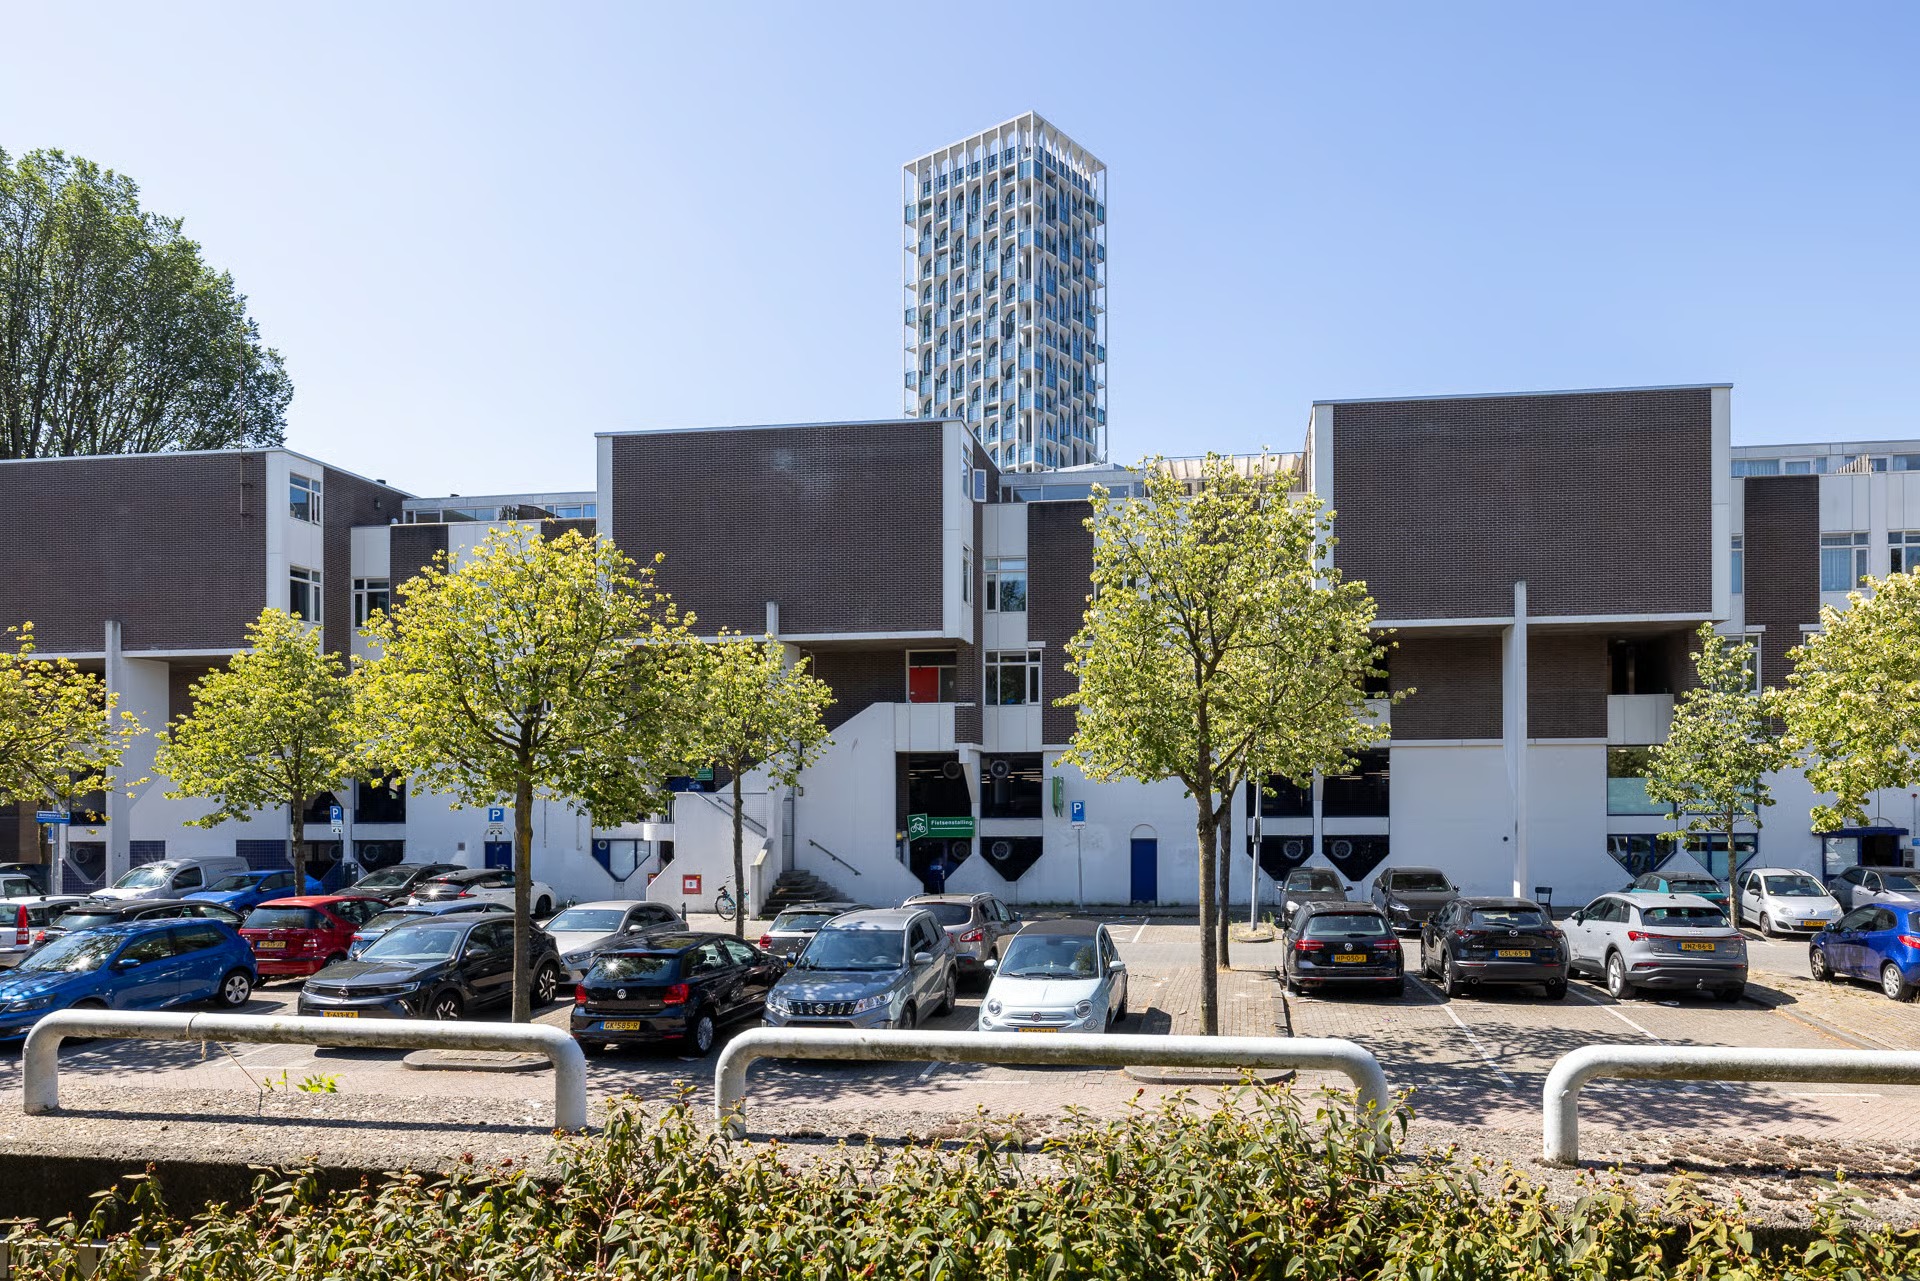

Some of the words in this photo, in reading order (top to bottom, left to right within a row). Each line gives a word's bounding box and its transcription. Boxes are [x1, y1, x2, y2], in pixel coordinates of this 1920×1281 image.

[333, 808, 338, 818] P
[1074, 803, 1081, 813] P
[492, 810, 501, 820] P
[605, 1021, 638, 1029] GK-585-R
